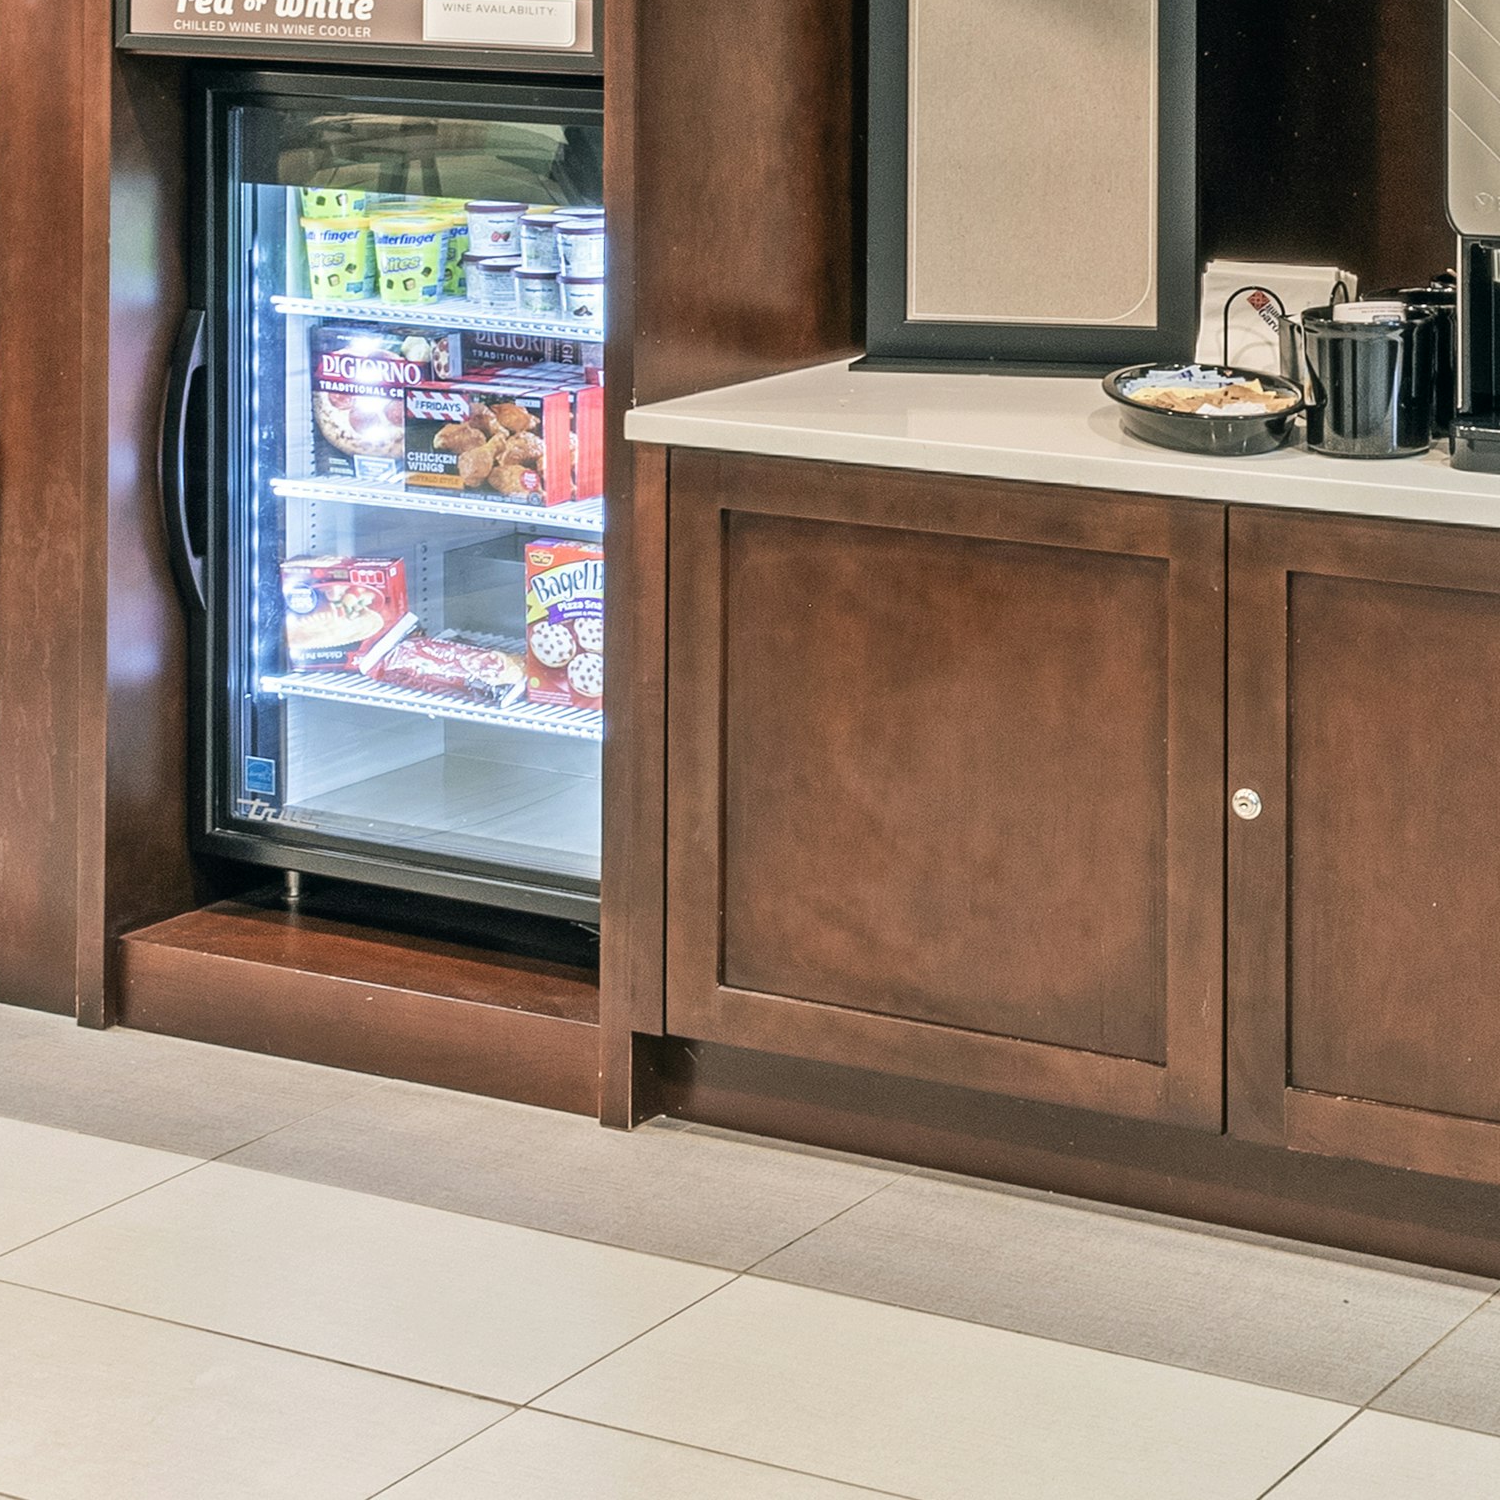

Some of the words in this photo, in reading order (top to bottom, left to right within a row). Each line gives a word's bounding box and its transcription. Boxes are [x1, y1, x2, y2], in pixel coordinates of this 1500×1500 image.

[442, 2, 471, 13] WINE
[475, 4, 558, 17] AVAILABILITY:
[173, 19, 225, 32] CHILLED
[228, 21, 261, 33] WINE
[265, 22, 278, 33] IN
[281, 23, 315, 35] WINE
[318, 25, 371, 37] COOLER
[320, 380, 386, 396] TRADITIONAL
[420, 400, 461, 412] FRIDAYS
[407, 451, 457, 465] CHICKEN
[407, 461, 445, 473] WINGS
[531, 561, 587, 603] Bagel
[558, 600, 583, 612] Pizza
